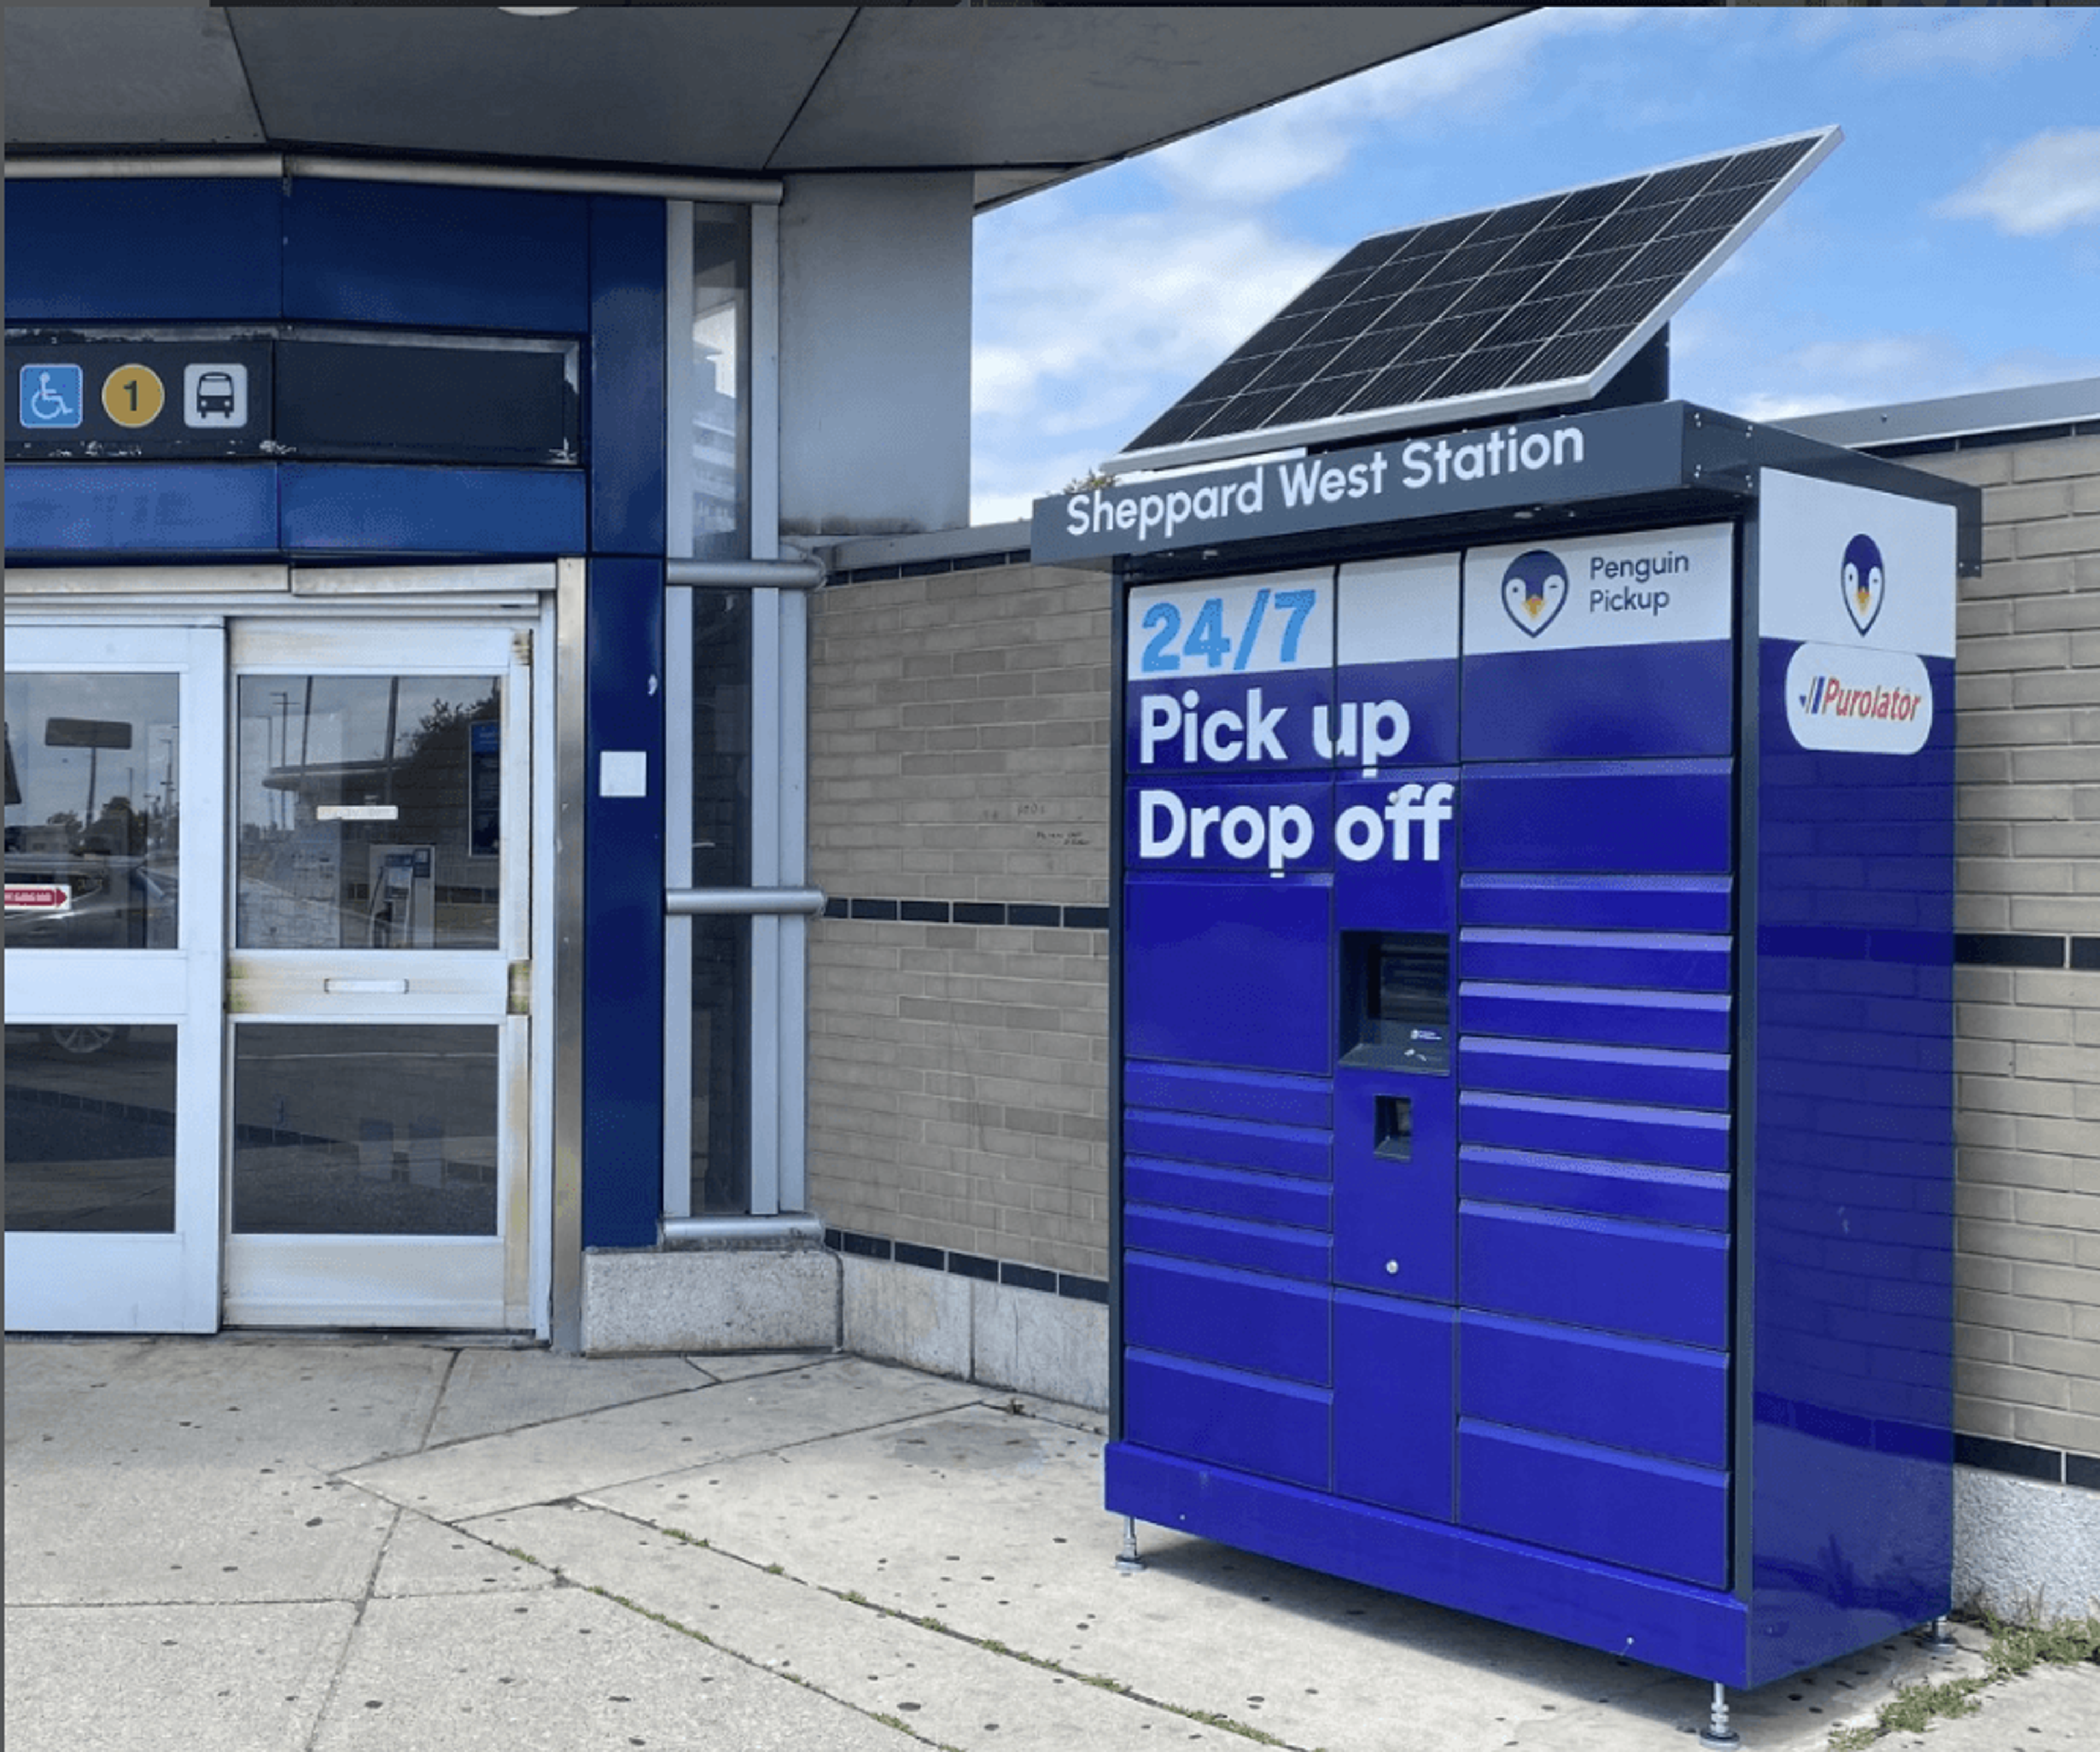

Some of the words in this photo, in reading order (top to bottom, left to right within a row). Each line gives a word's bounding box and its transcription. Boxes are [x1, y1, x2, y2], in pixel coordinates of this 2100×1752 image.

[122, 379, 138, 411] 1
[1066, 465, 1264, 540] Sheppard
[1278, 450, 1389, 509] West
[1401, 426, 1584, 490] Station
[1590, 551, 1689, 583] Penguin
[1141, 588, 1317, 673] 24/7
[1590, 586, 1670, 616] Pickup
[1822, 676, 1921, 721] Purolator
[1140, 687, 1288, 764] Pick
[1312, 699, 1410, 778] up
[1139, 789, 1314, 878] Drop
[1335, 782, 1455, 861] off
